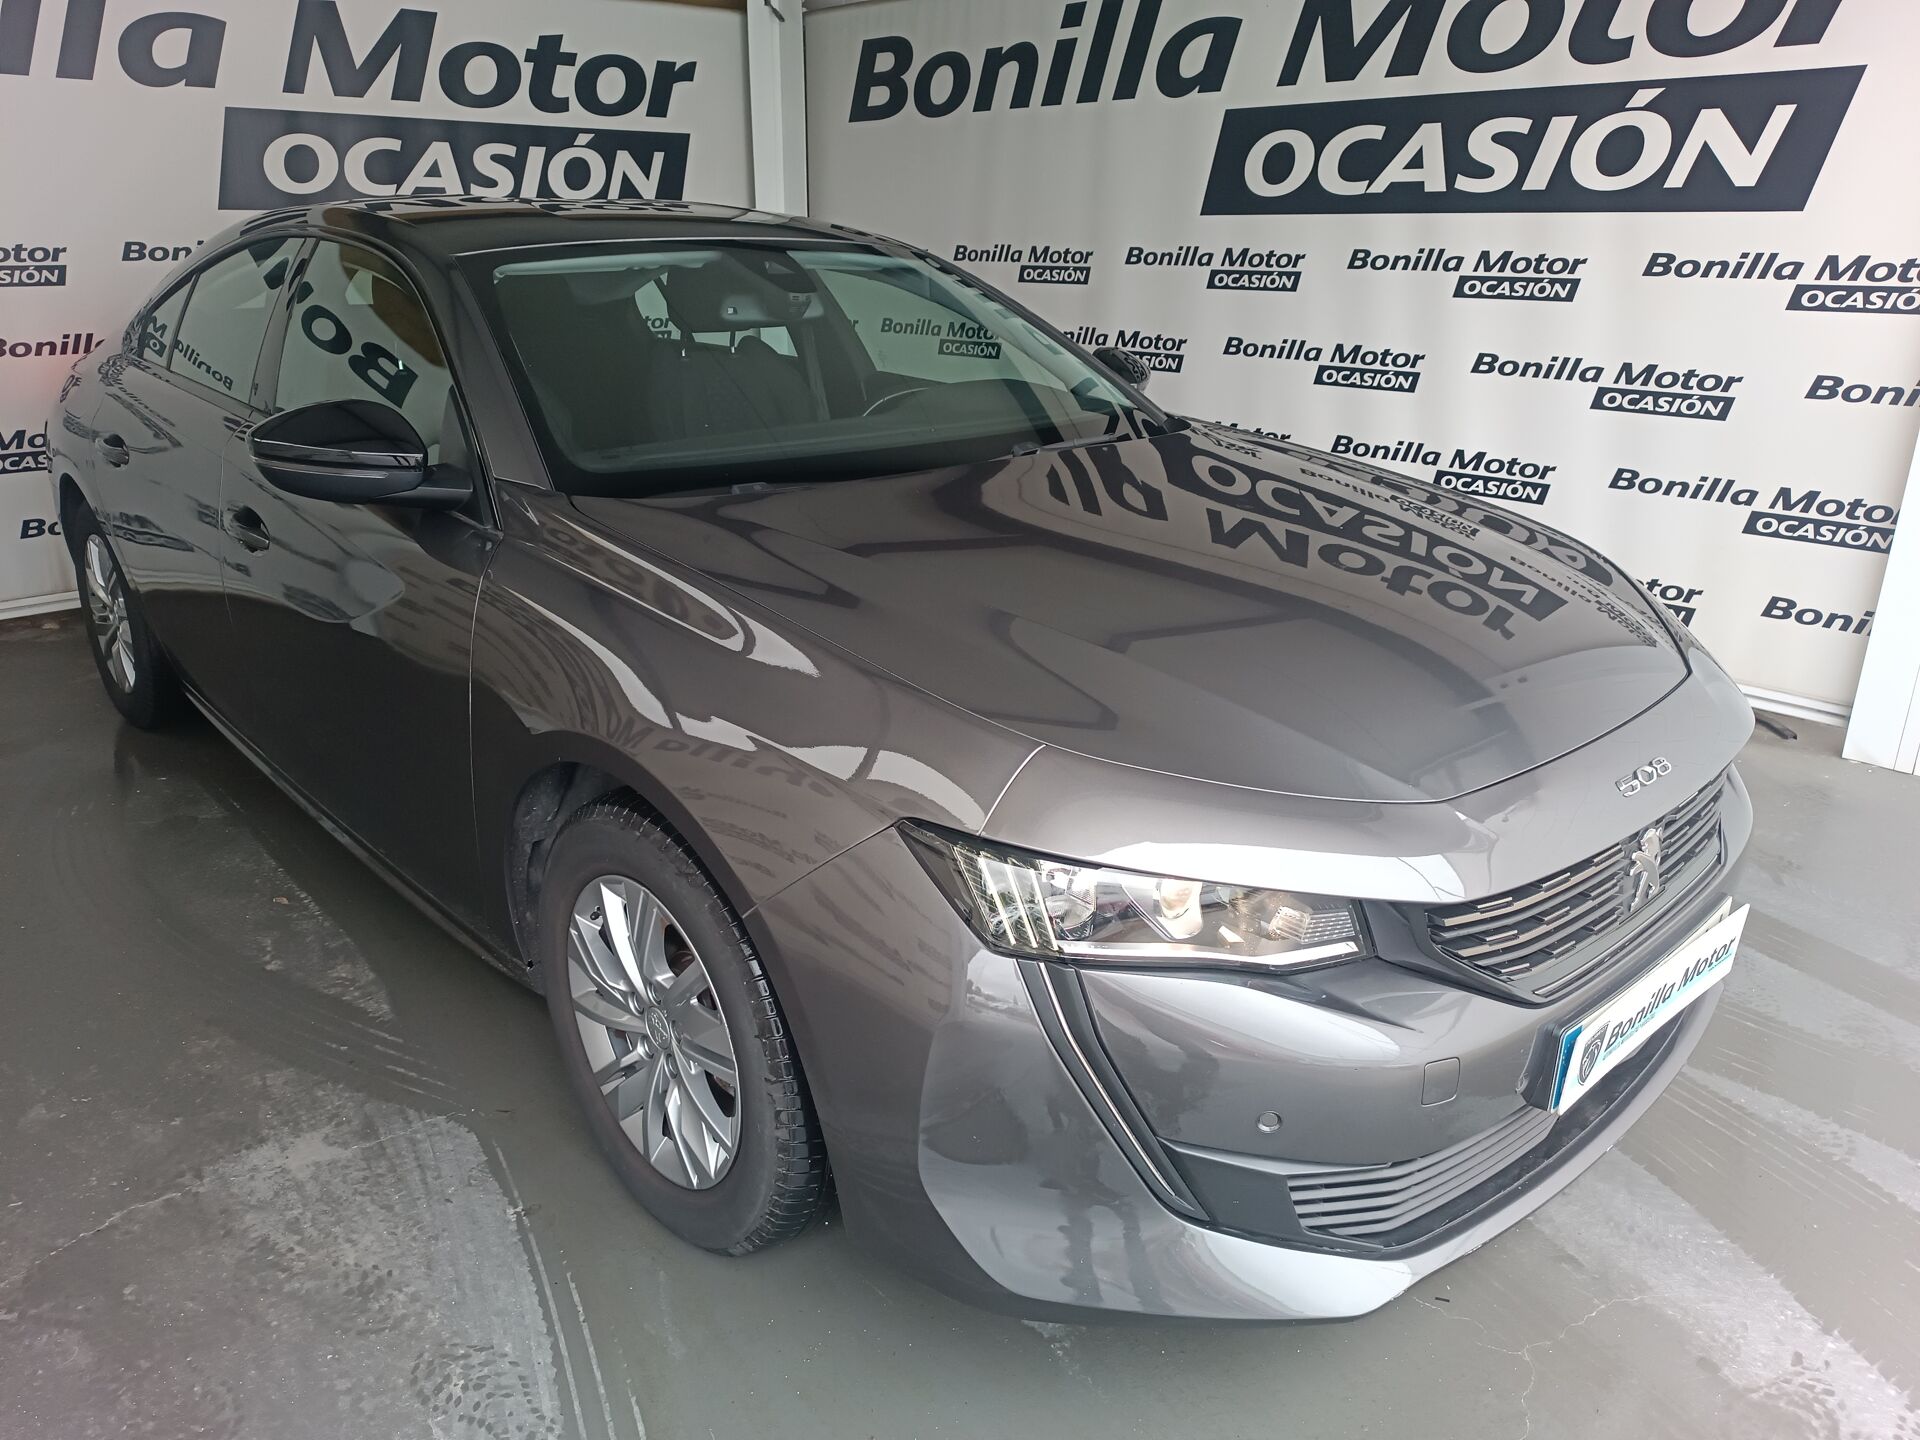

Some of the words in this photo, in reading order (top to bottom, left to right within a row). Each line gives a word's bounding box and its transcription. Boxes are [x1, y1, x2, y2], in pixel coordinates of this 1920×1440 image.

[282, 0, 697, 118] Motor
[849, 0, 1243, 123] Bonilla
[1243, 87, 1797, 197] OCASIÓN
[263, 133, 664, 200] OCASIÓN
[953, 244, 1023, 263] Bonilla
[1028, 246, 1094, 264] Motor
[1124, 246, 1214, 267] Bonilla
[1221, 247, 1306, 269] Motor
[1347, 248, 1465, 272] Bonilla
[1472, 250, 1588, 275] Motor
[1641, 252, 1805, 281] Bonilla
[1814, 254, 1920, 283] Mot
[1023, 267, 1087, 283] OCASIÓN
[1213, 271, 1296, 289] OCASIÓN
[1463, 278, 1572, 298] OCASIÓN
[880, 317, 942, 337] Bonilla
[1114, 329, 1188, 351] Motor
[943, 342, 998, 357] OCASIÓN
[1223, 336, 1323, 362] Bonilla
[1329, 343, 1426, 369] Motor
[1322, 369, 1413, 390] OCASIÓN
[1470, 352, 1605, 383] Bonilla
[1612, 362, 1744, 392] Motor
[1601, 391, 1724, 417] OCASIÓN
[1331, 434, 1442, 466] Bonilla
[1449, 449, 1557, 480] Motor
[1440, 475, 1543, 501] OCASIÓN
[1608, 467, 1759, 507] Bonilla
[1756, 517, 1895, 550] OCASIÓN
[1616, 756, 1673, 798] 508
[1604, 982, 1676, 1053] Bonilla
[1677, 936, 1737, 992] Motor
